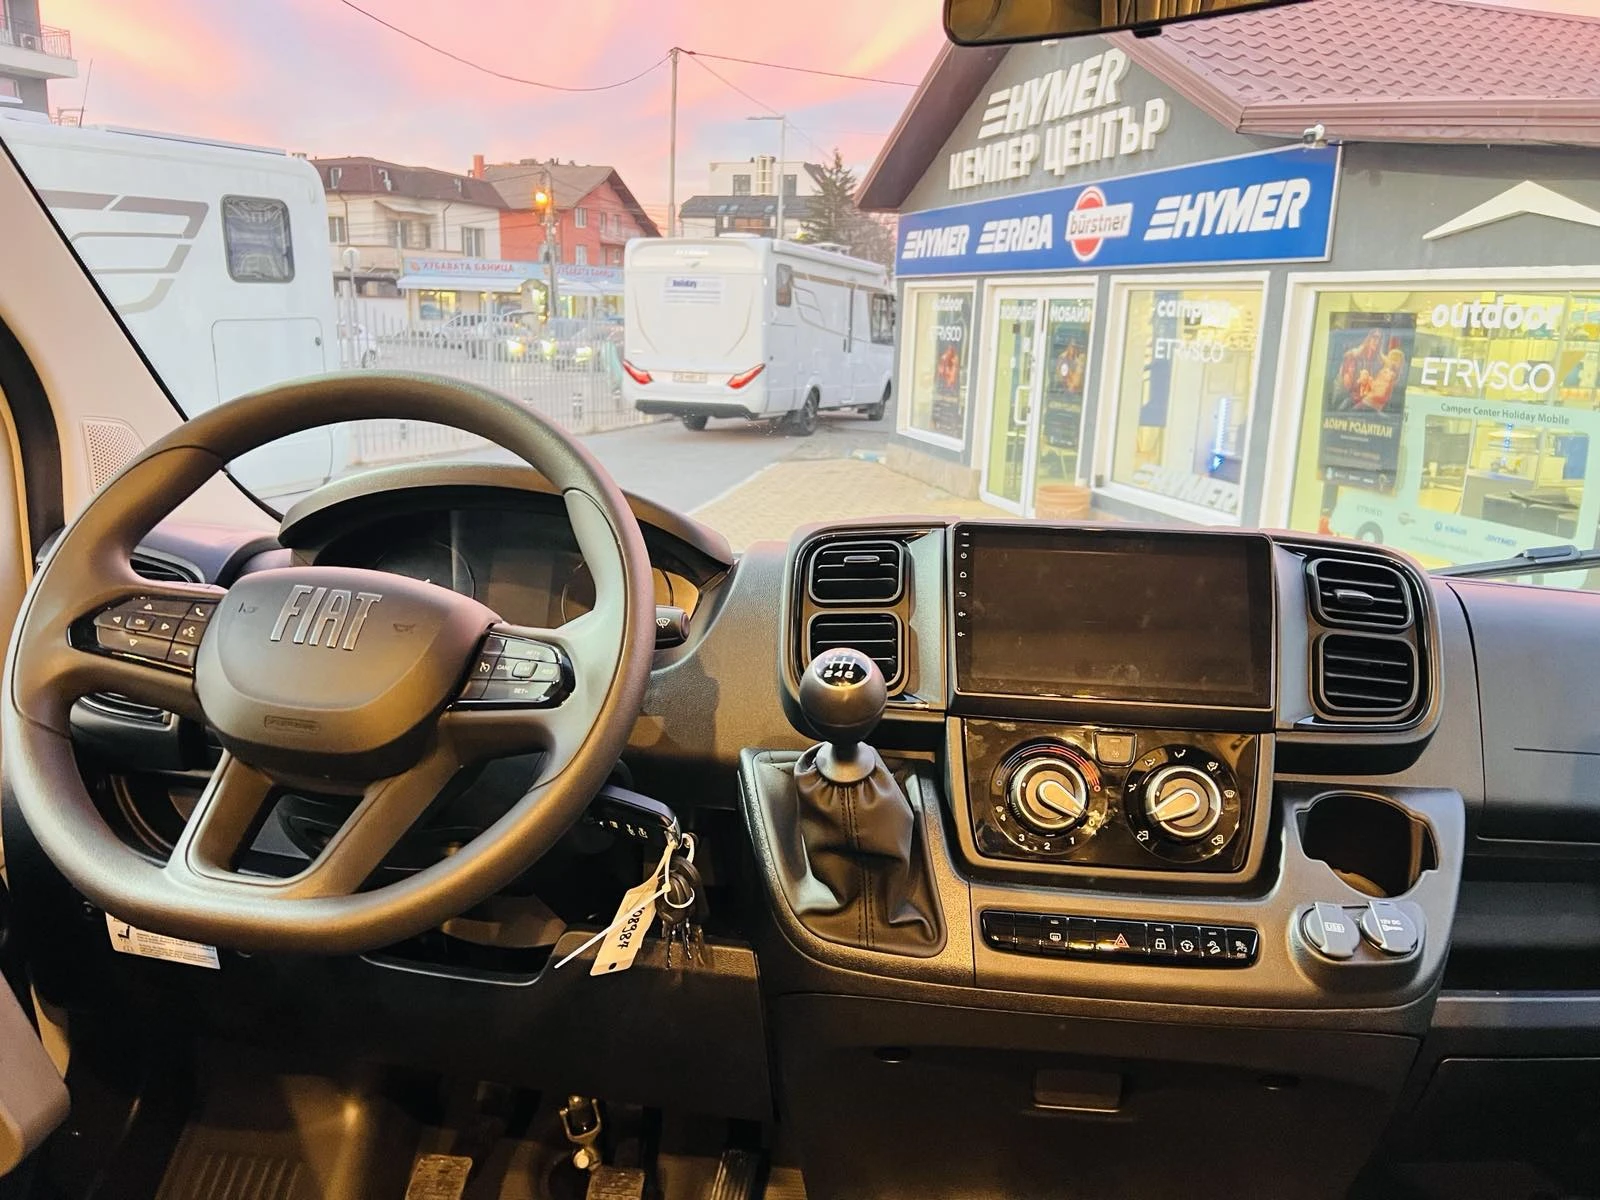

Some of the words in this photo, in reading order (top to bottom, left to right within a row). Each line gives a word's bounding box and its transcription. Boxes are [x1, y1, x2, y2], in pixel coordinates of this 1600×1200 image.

[1003, 48, 1130, 134] HYMER
[949, 132, 1039, 190] КЕМПЕР
[1043, 98, 1170, 176] ЦЕНТЪР
[1069, 214, 1128, 236] bürstner
[1172, 178, 1311, 239] HYMER
[914, 225, 970, 258] HYMER
[995, 214, 1053, 252] ERIBA
[1431, 297, 1564, 330] outdoor
[1440, 402, 1471, 415] Camper
[1473, 406, 1501, 418] Center
[1502, 409, 1536, 423] Holiday
[1537, 412, 1570, 425] Mobile
[270, 584, 383, 651] FIAT
[1018, 834, 1025, 842] 3
[1043, 842, 1051, 851] 2
